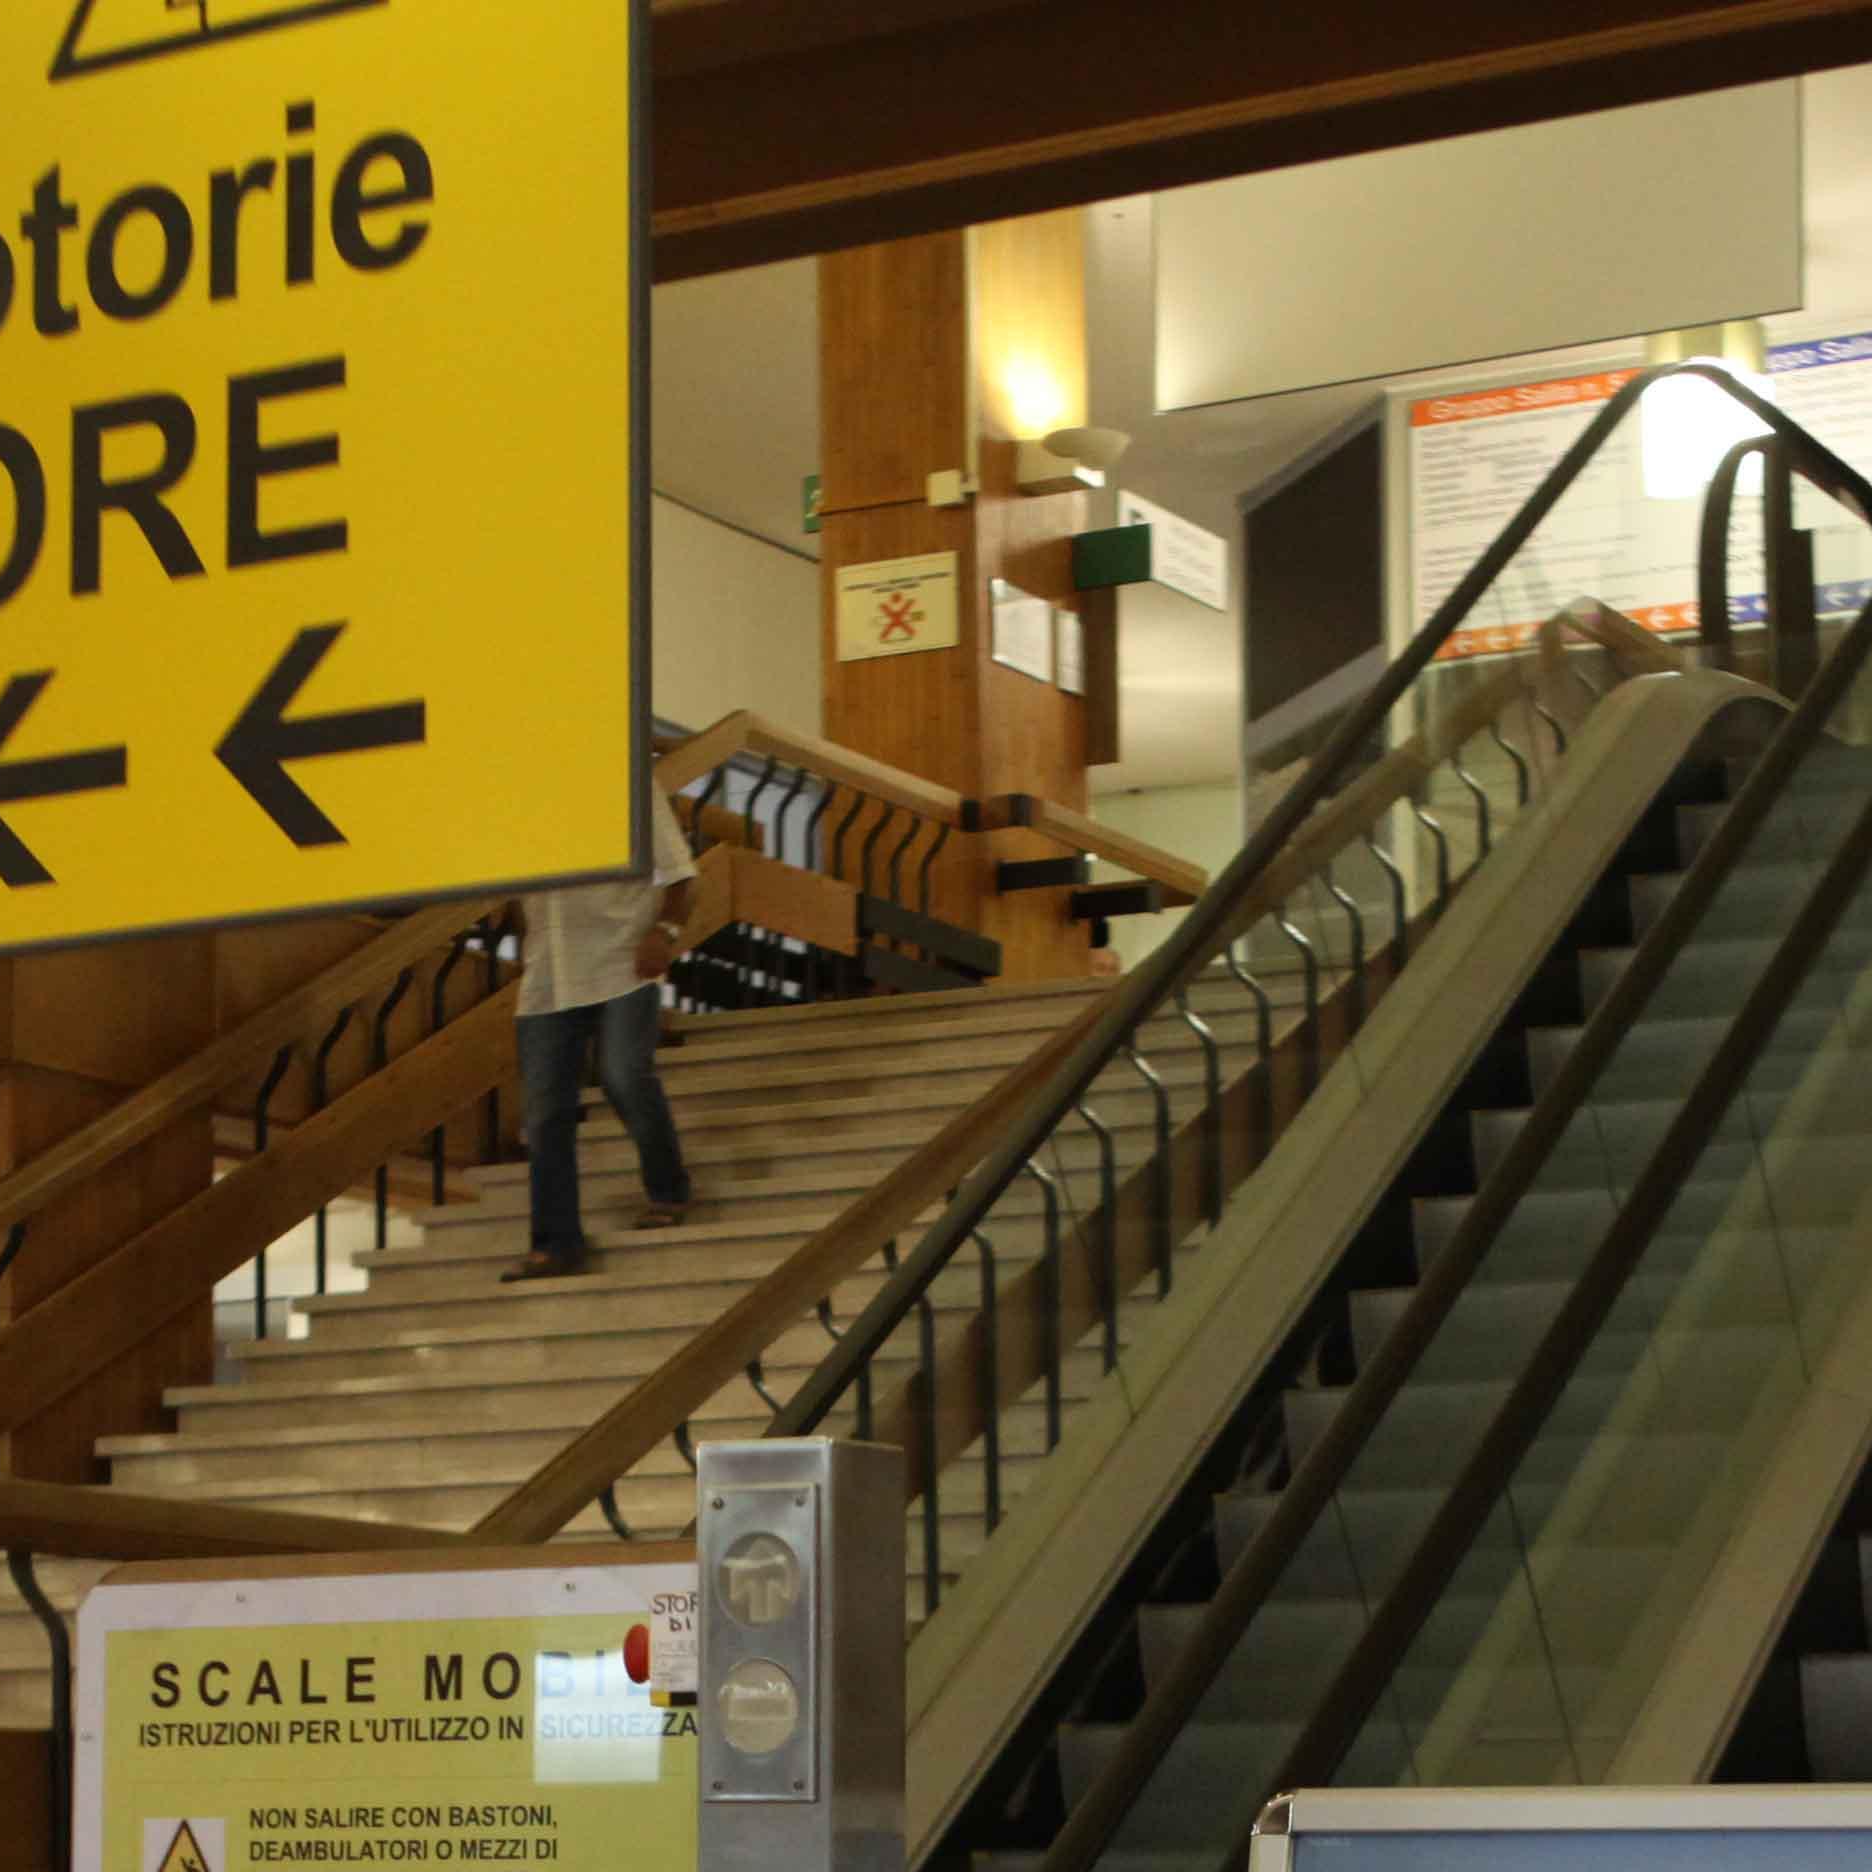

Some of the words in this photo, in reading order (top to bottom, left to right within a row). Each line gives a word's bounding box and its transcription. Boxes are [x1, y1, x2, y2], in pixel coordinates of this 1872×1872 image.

[150, 1656, 376, 1708] SCALE
[424, 1650, 649, 1700] MOBI
[139, 1722, 281, 1748] ISTRUZIONI
[289, 1720, 339, 1746] PER
[349, 1718, 490, 1744] L'UTILIZZO
[499, 1716, 524, 1741] IN
[540, 1712, 698, 1739] SICUREZZA
[250, 1808, 297, 1829] NON
[304, 1808, 385, 1829] SALIRE
[392, 1808, 440, 1828] CON
[449, 1806, 558, 1831] BASTONI,
[249, 1839, 428, 1862] DEAMBULATORI
[436, 1839, 453, 1861] O
[460, 1839, 527, 1861] MEZZI
[535, 1839, 557, 1860] DI
